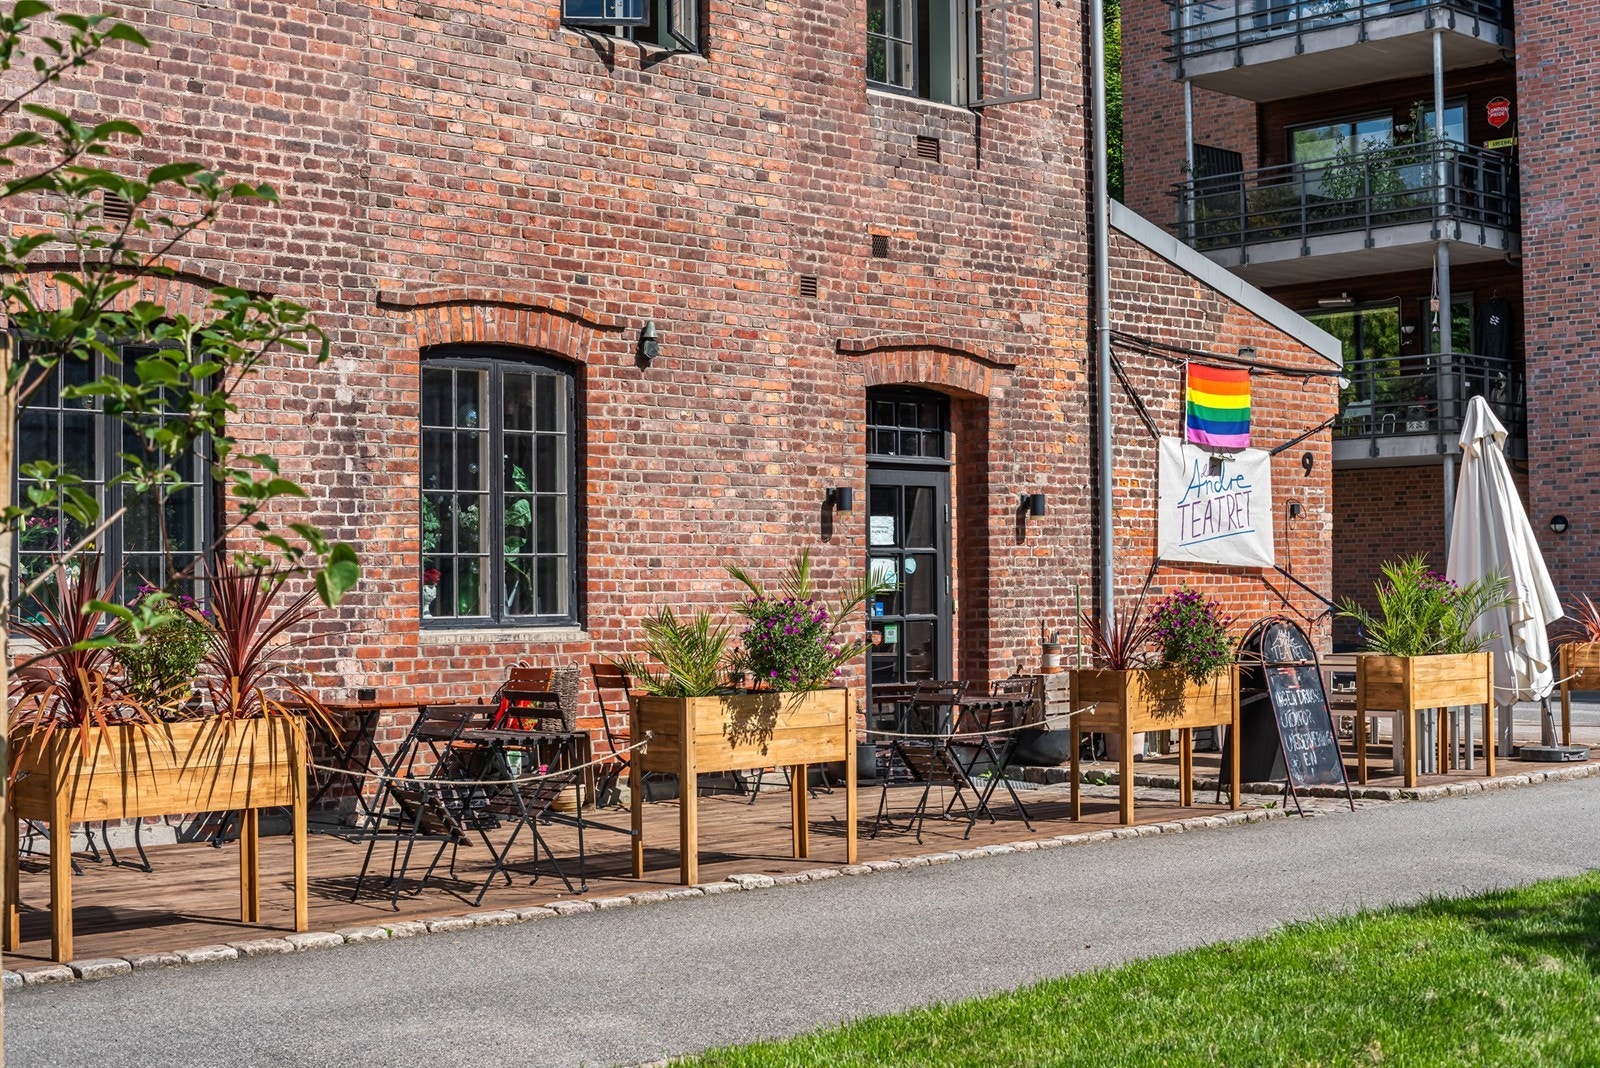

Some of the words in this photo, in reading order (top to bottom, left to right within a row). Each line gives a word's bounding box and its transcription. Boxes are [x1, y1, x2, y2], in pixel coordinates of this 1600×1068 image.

[1177, 458, 1252, 505] Andre
[1301, 451, 1314, 477] 9
[1177, 490, 1252, 541] TEATRET
